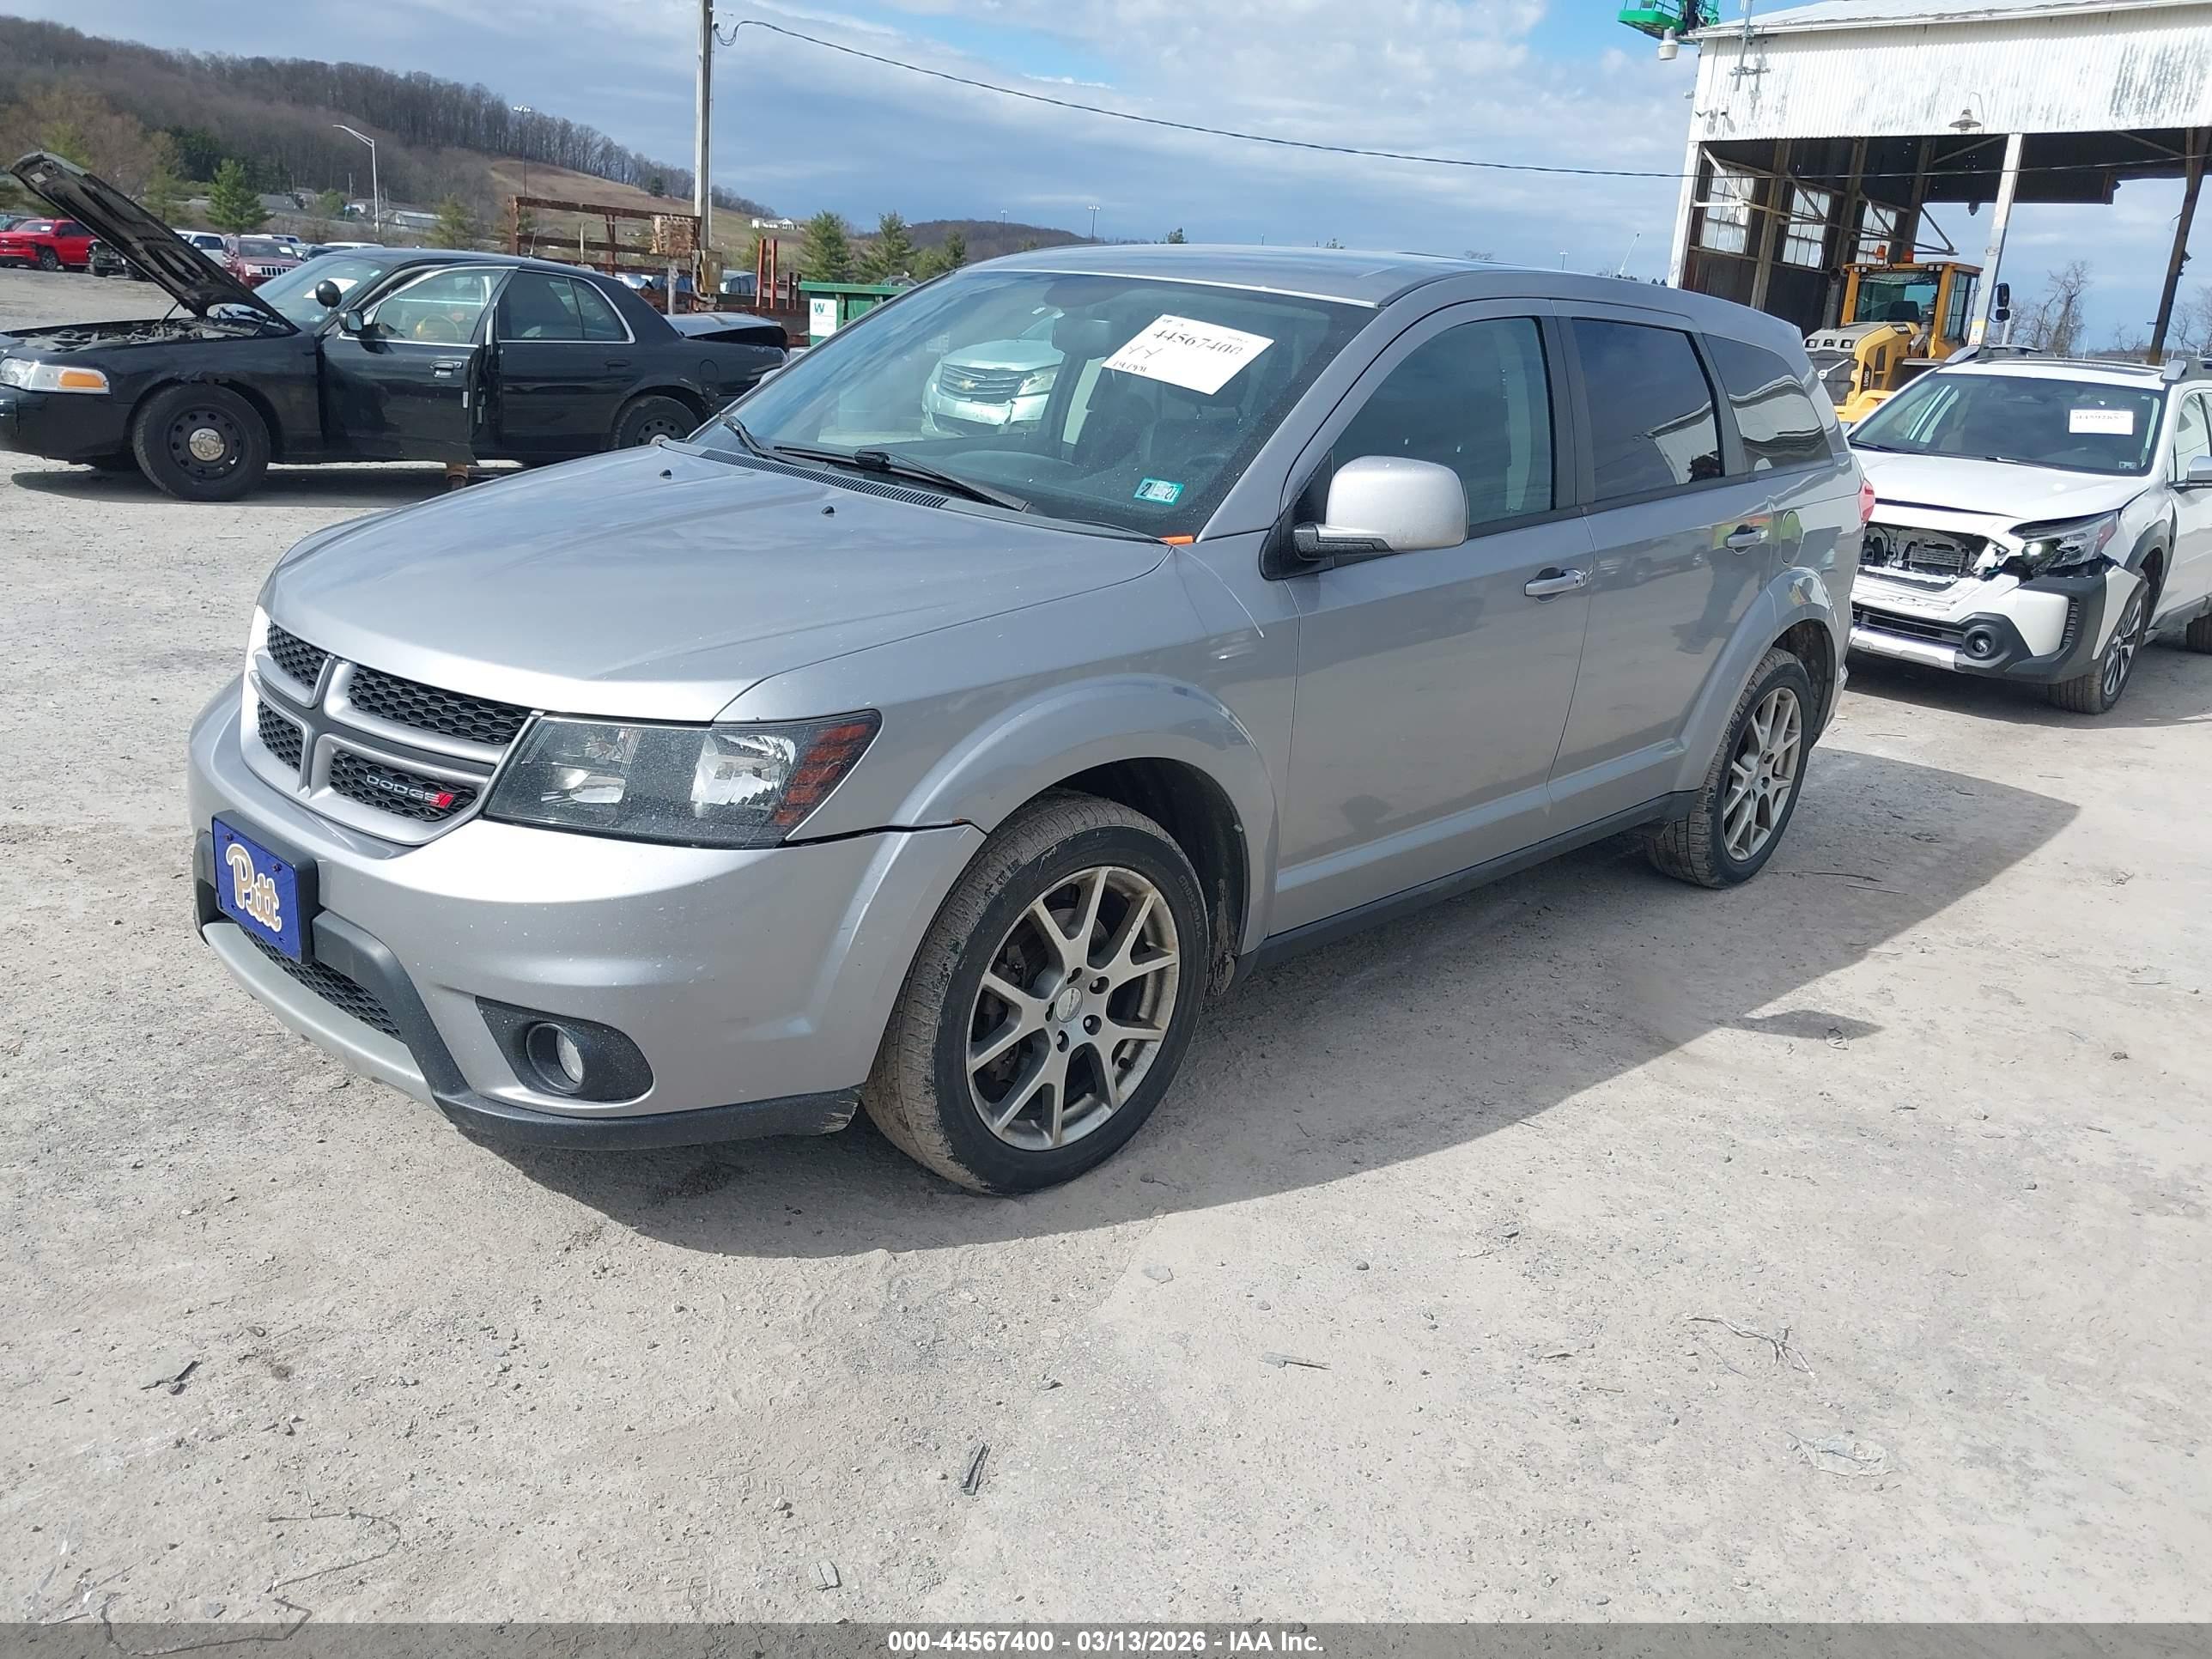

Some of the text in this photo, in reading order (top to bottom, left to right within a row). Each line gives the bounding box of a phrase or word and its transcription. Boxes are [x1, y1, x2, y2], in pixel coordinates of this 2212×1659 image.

[1139, 482, 1152, 497] 2
[366, 775, 441, 804] DODGE
[226, 843, 283, 933] Pitt
